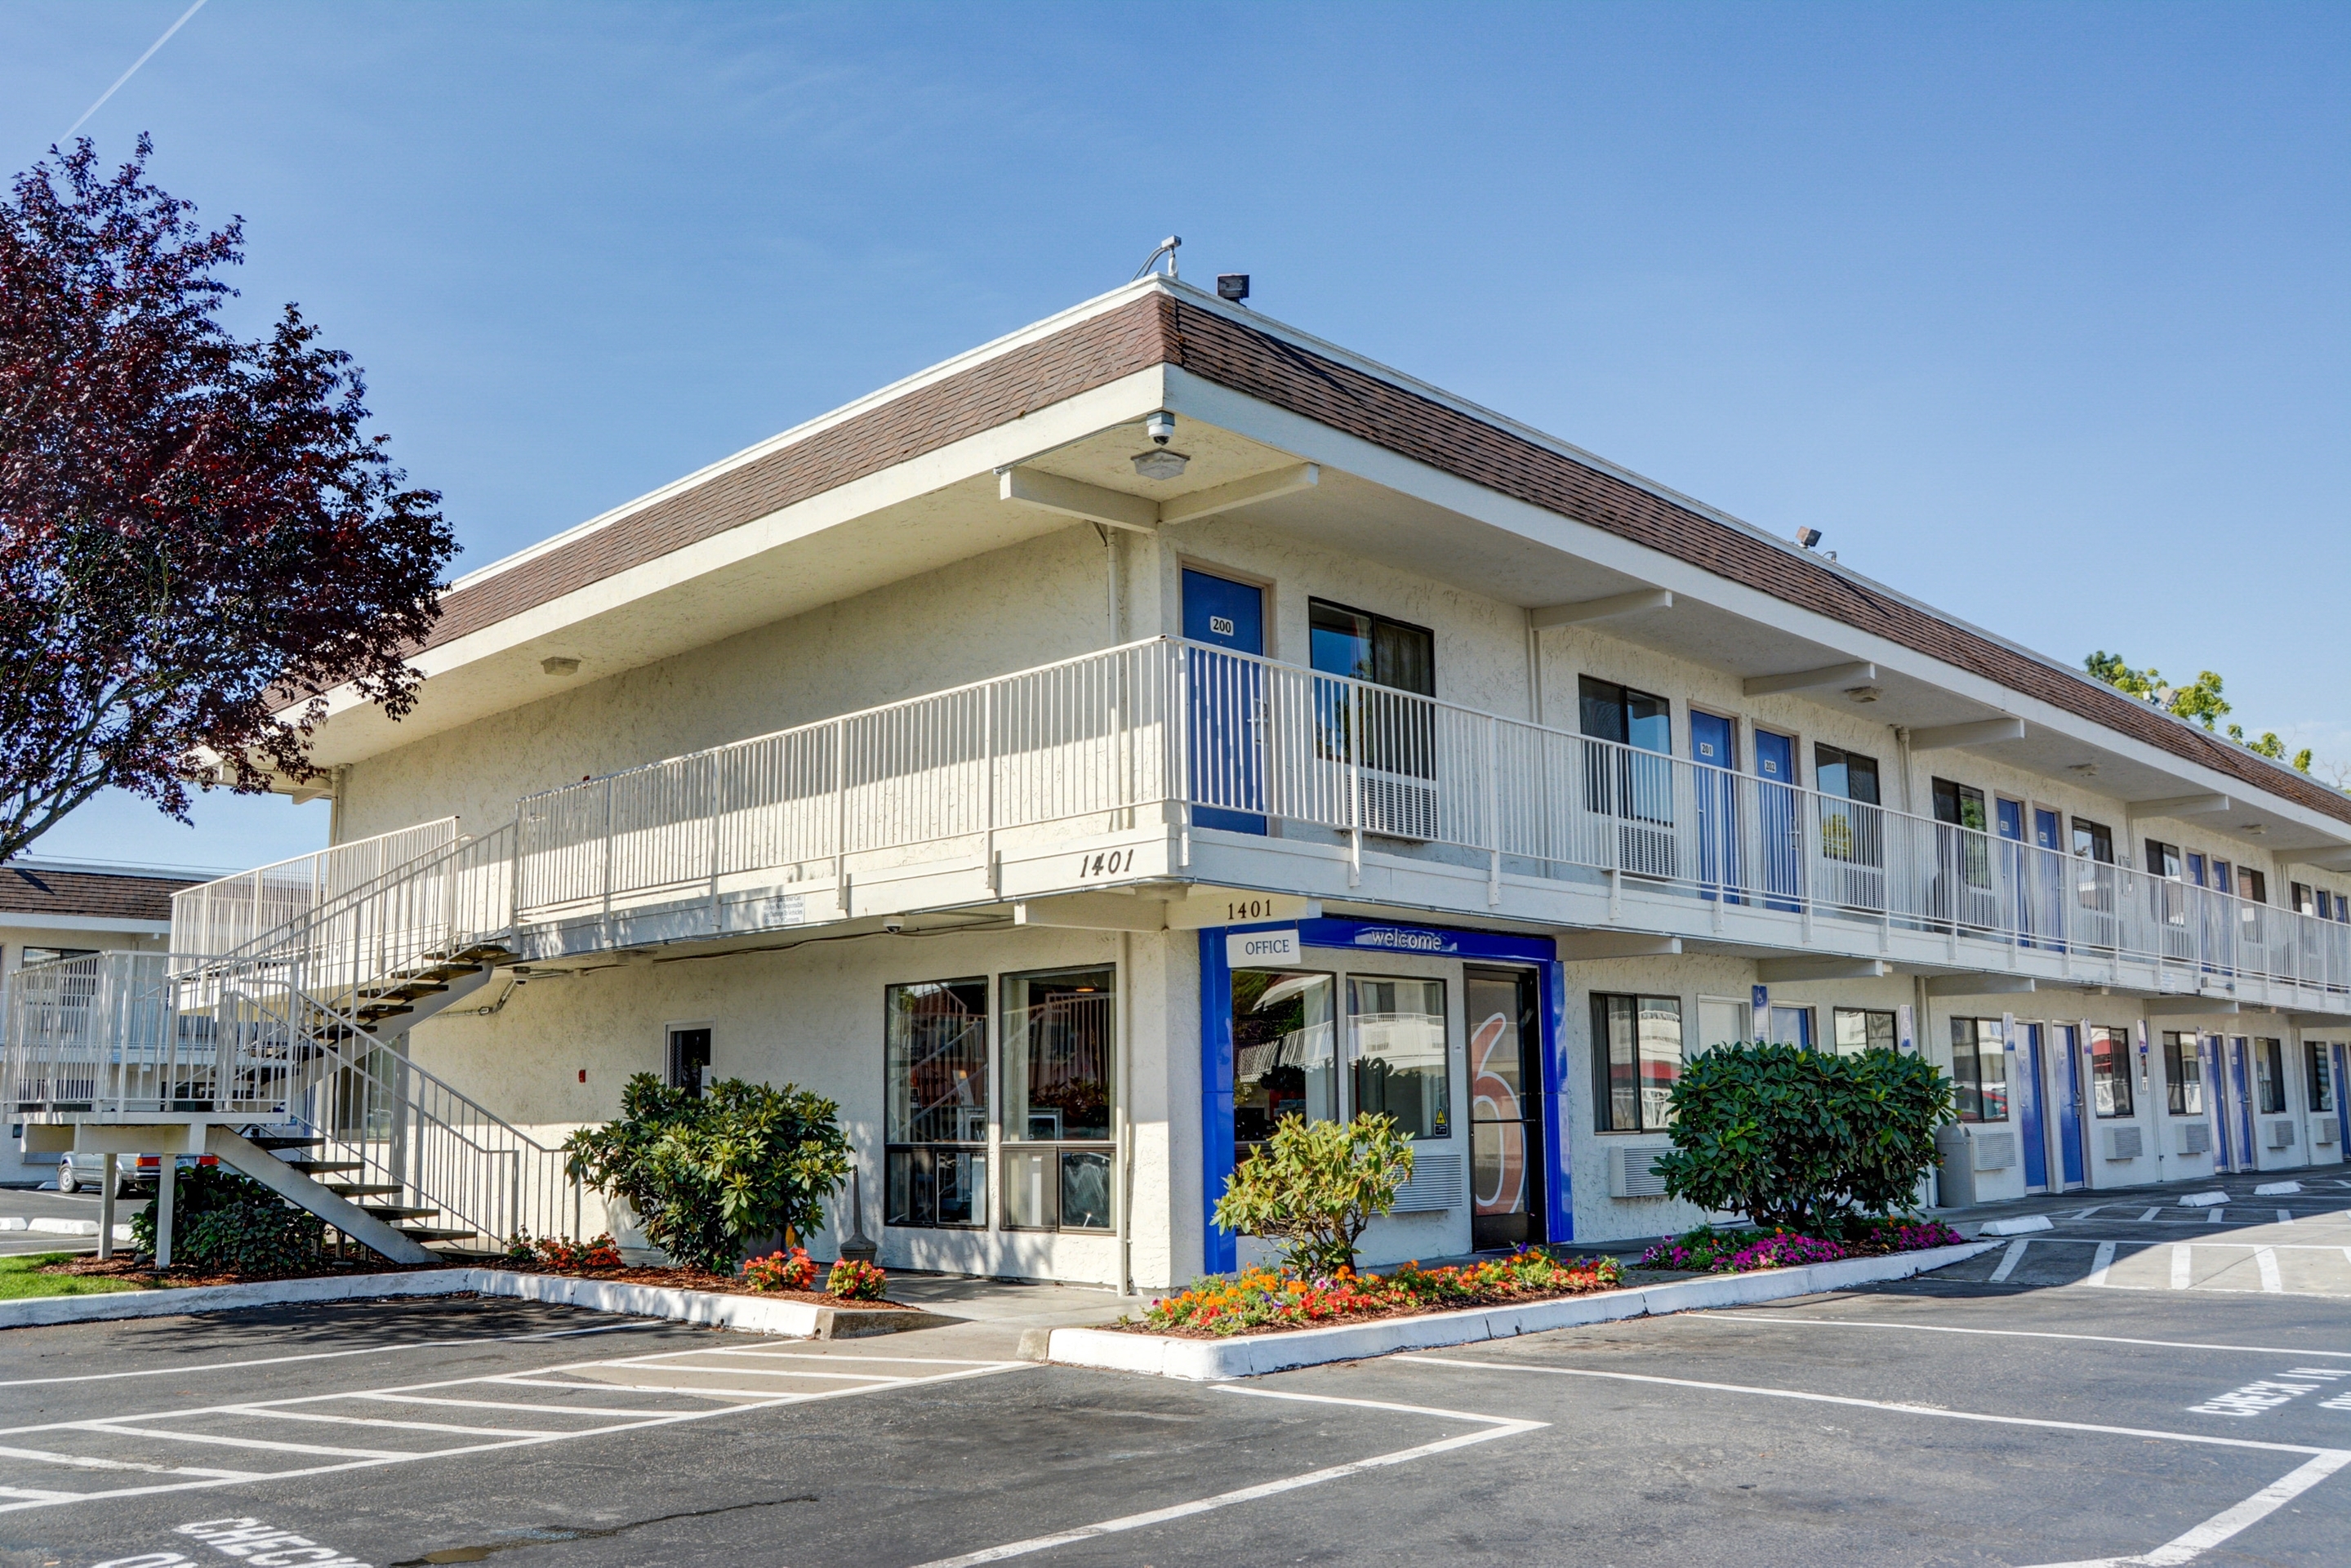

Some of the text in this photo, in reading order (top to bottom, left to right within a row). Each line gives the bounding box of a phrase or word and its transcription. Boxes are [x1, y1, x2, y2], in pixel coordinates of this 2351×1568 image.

[1213, 618, 1231, 633] 200
[1702, 744, 1712, 755] 201
[1080, 849, 1134, 878] 1401
[1227, 899, 1271, 920] 1401
[1245, 939, 1290, 955] OFFICE
[1372, 928, 1442, 951] welcome
[2185, 1380, 2320, 1416] CHECK
